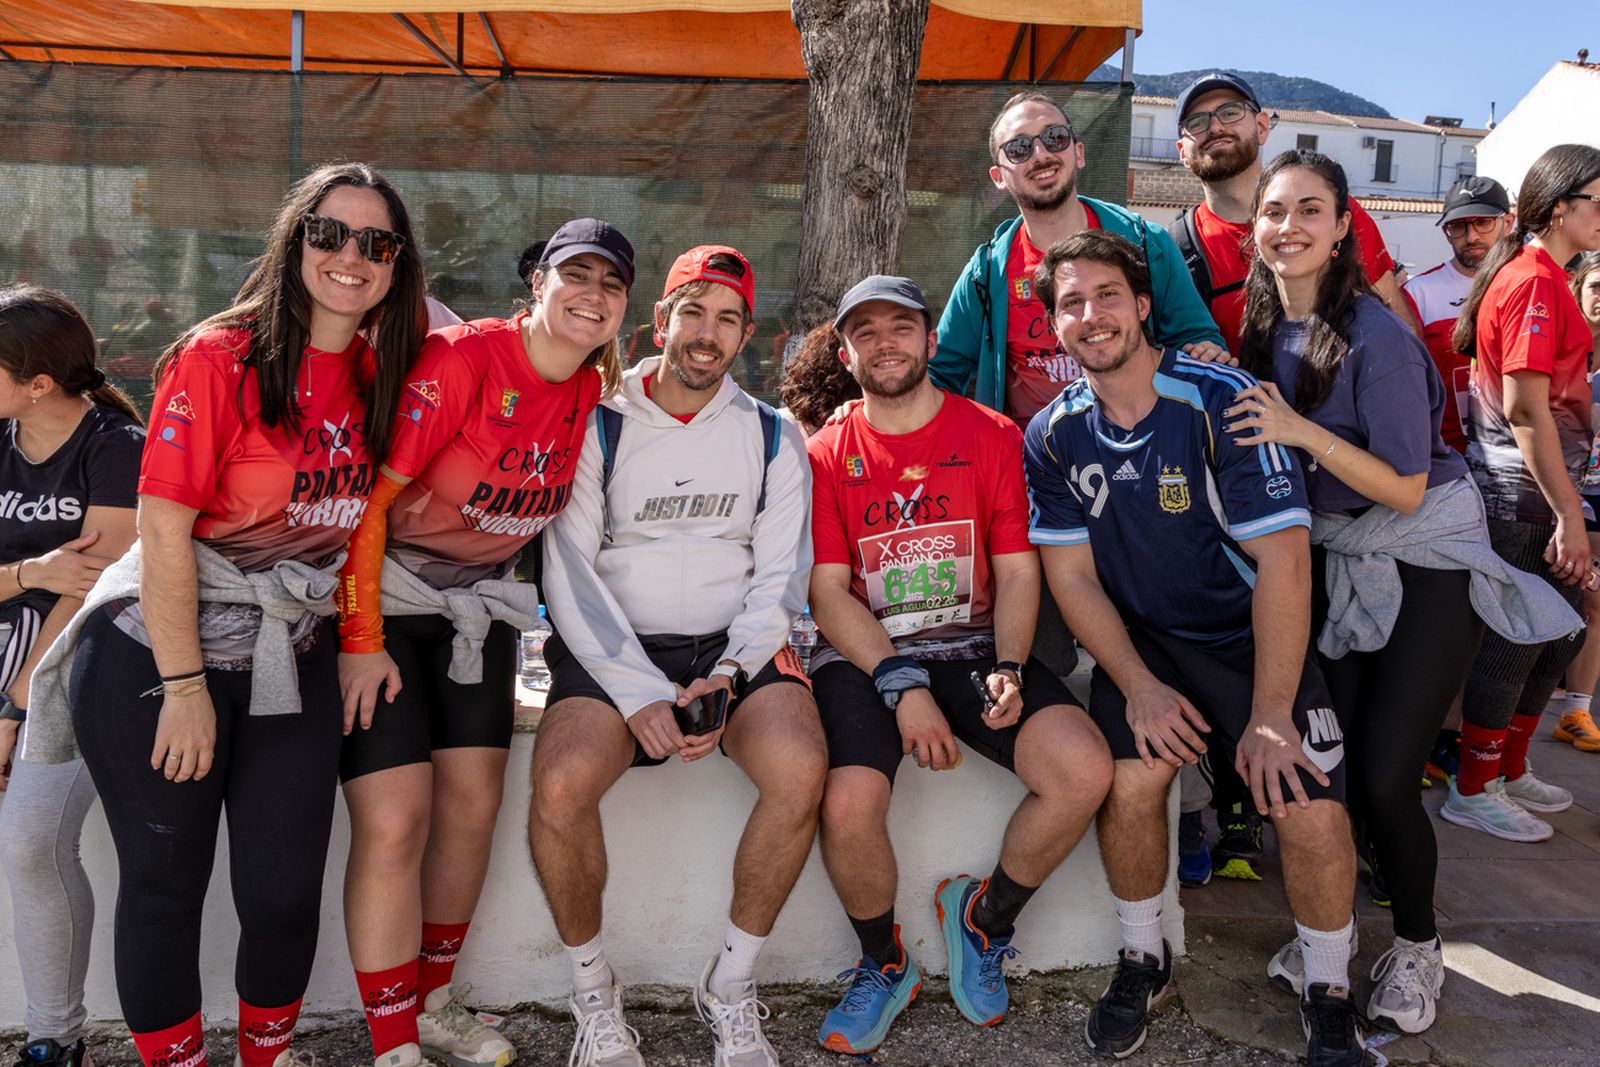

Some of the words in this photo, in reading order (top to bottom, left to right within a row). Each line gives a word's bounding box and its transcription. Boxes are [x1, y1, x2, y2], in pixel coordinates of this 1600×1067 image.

[634, 496, 690, 522] JUST
[687, 494, 720, 518] DO
[716, 493, 740, 517] IT
[864, 495, 950, 527] CROSS
[878, 539, 895, 560] X
[897, 535, 956, 555] CROSS
[880, 551, 944, 573] PANTANO
[885, 561, 957, 604] 645
